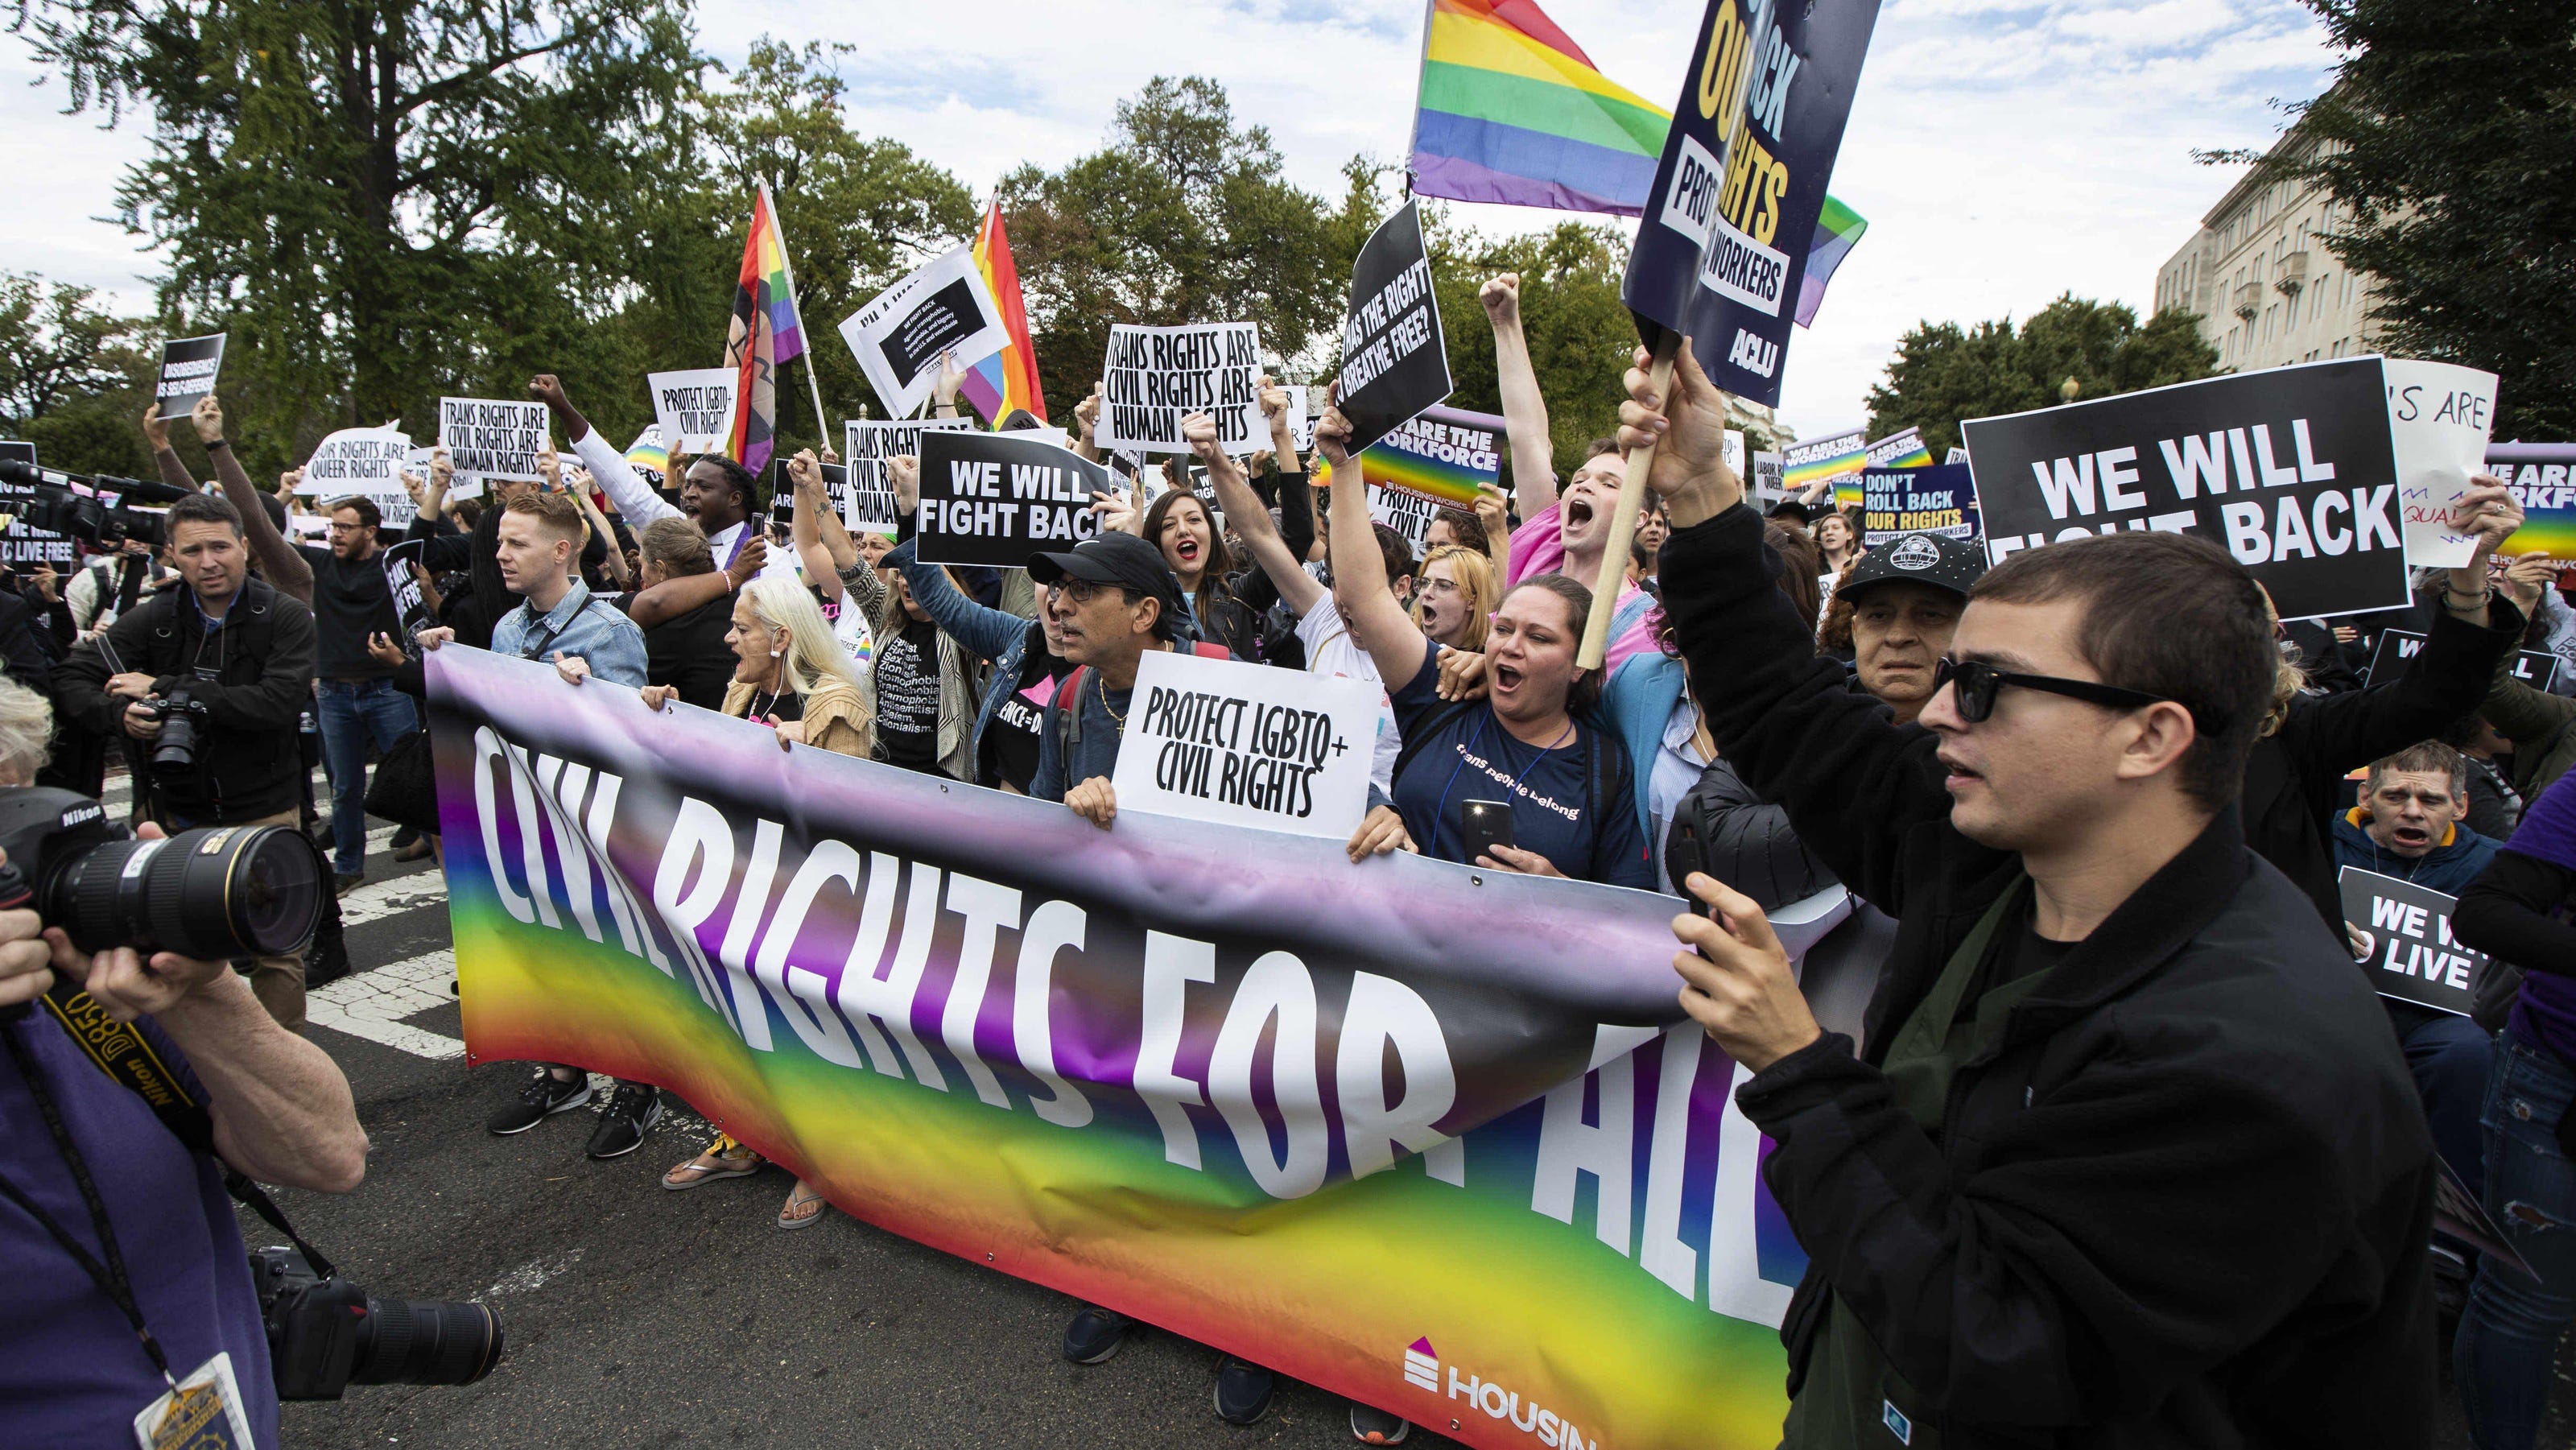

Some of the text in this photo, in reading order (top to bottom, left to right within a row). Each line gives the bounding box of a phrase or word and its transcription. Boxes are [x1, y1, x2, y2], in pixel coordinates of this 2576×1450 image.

[922, 299, 936, 313] BACK
[1346, 257, 1427, 357] HAS THE RIGHT
[926, 333, 935, 343] and
[928, 322, 938, 332] and
[1108, 329, 1257, 370] TRANS RIGHTS ARE
[1342, 335, 1393, 398] BREATHE
[1389, 304, 1431, 361] FREE?
[1728, 327, 1778, 378] ACLU
[157, 382, 167, 398] IS
[662, 386, 733, 412] PROTECT LGBTQ+
[1107, 368, 1143, 406] CIVIL
[1147, 370, 1214, 407] RIGHTS
[1220, 366, 1253, 405] ARE
[444, 403, 544, 429] TRANS RIGHTS ARE
[679, 411, 725, 435] CIVIL RIGHTS
[1113, 405, 1175, 443] HUMAN
[2434, 390, 2487, 431] ARE
[340, 441, 380, 459] RIGHTS
[383, 442, 406, 461] ARE
[448, 425, 539, 452] CIVIL RIGHTS ARE
[849, 427, 879, 459] TRANS
[1404, 418, 1493, 452] ARE THE
[1790, 433, 1860, 458] WE ARE THE
[452, 448, 494, 472] HUMAN
[496, 451, 537, 474] RIGHTS
[1377, 432, 1499, 473] ORKFORCE
[1757, 461, 1777, 476] LABOR
[1785, 440, 1865, 467] WORKFORCE
[312, 459, 390, 479] QUEER RIGHTS
[851, 459, 877, 491] CIVIL
[951, 460, 1001, 498] WE
[1011, 463, 1090, 502] WILL
[1865, 473, 1916, 493] DON'T
[2031, 418, 2335, 520] WE WILL
[1395, 482, 1468, 510] HOUSING WORKS
[1865, 490, 1954, 511] ROLL BACK
[919, 498, 1019, 538] FIGHT
[1865, 508, 1963, 531] OUR RIGHTS
[2221, 484, 2401, 565] BACK
[15, 540, 44, 562] LIVE
[45, 541, 72, 562] FREE
[1141, 685, 1348, 773] PROTECT LGBTQ+
[1156, 741, 1317, 818] CIVIL RIGHTS
[1455, 743, 1580, 821] trans people belong
[62, 805, 101, 828] Nikon
[2371, 895, 2429, 940] WE
[2383, 938, 2472, 990] LIVE
[474, 725, 1796, 1331] CIVIL RIGHTS FOR ALL
[64, 991, 174, 1107] Nikon D850
